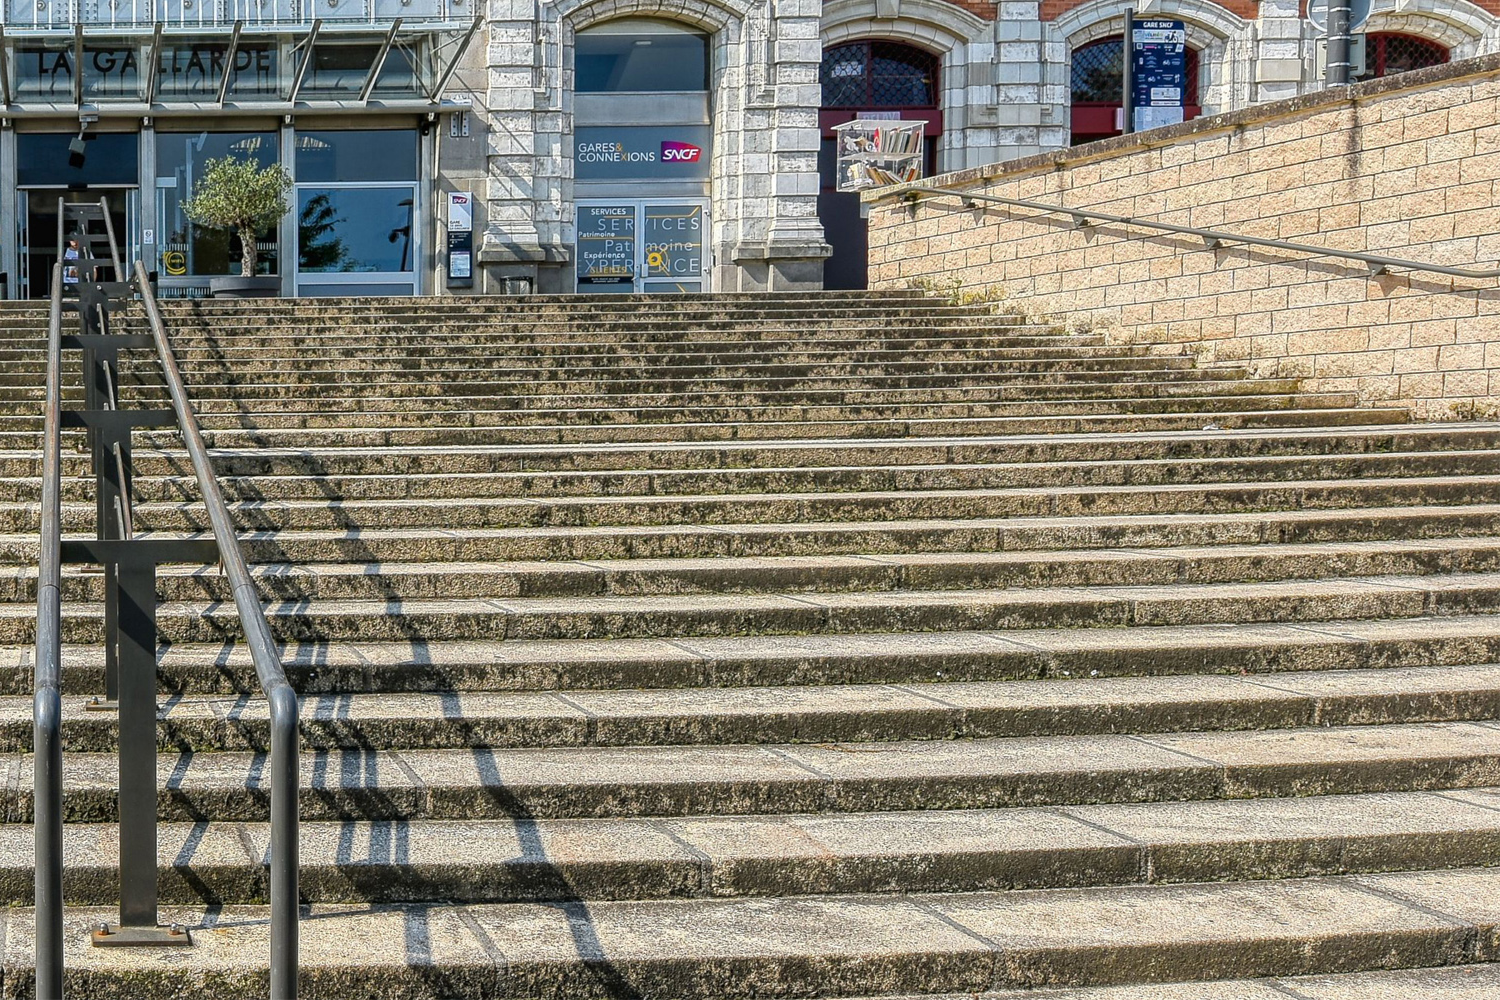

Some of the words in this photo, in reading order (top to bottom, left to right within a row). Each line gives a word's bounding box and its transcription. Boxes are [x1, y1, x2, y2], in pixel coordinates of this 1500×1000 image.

[578, 152, 655, 162] CONNEXIONS
[663, 149, 699, 160] SNCF
[598, 218, 699, 230] SERICES
[584, 252, 626, 260] Expérience
